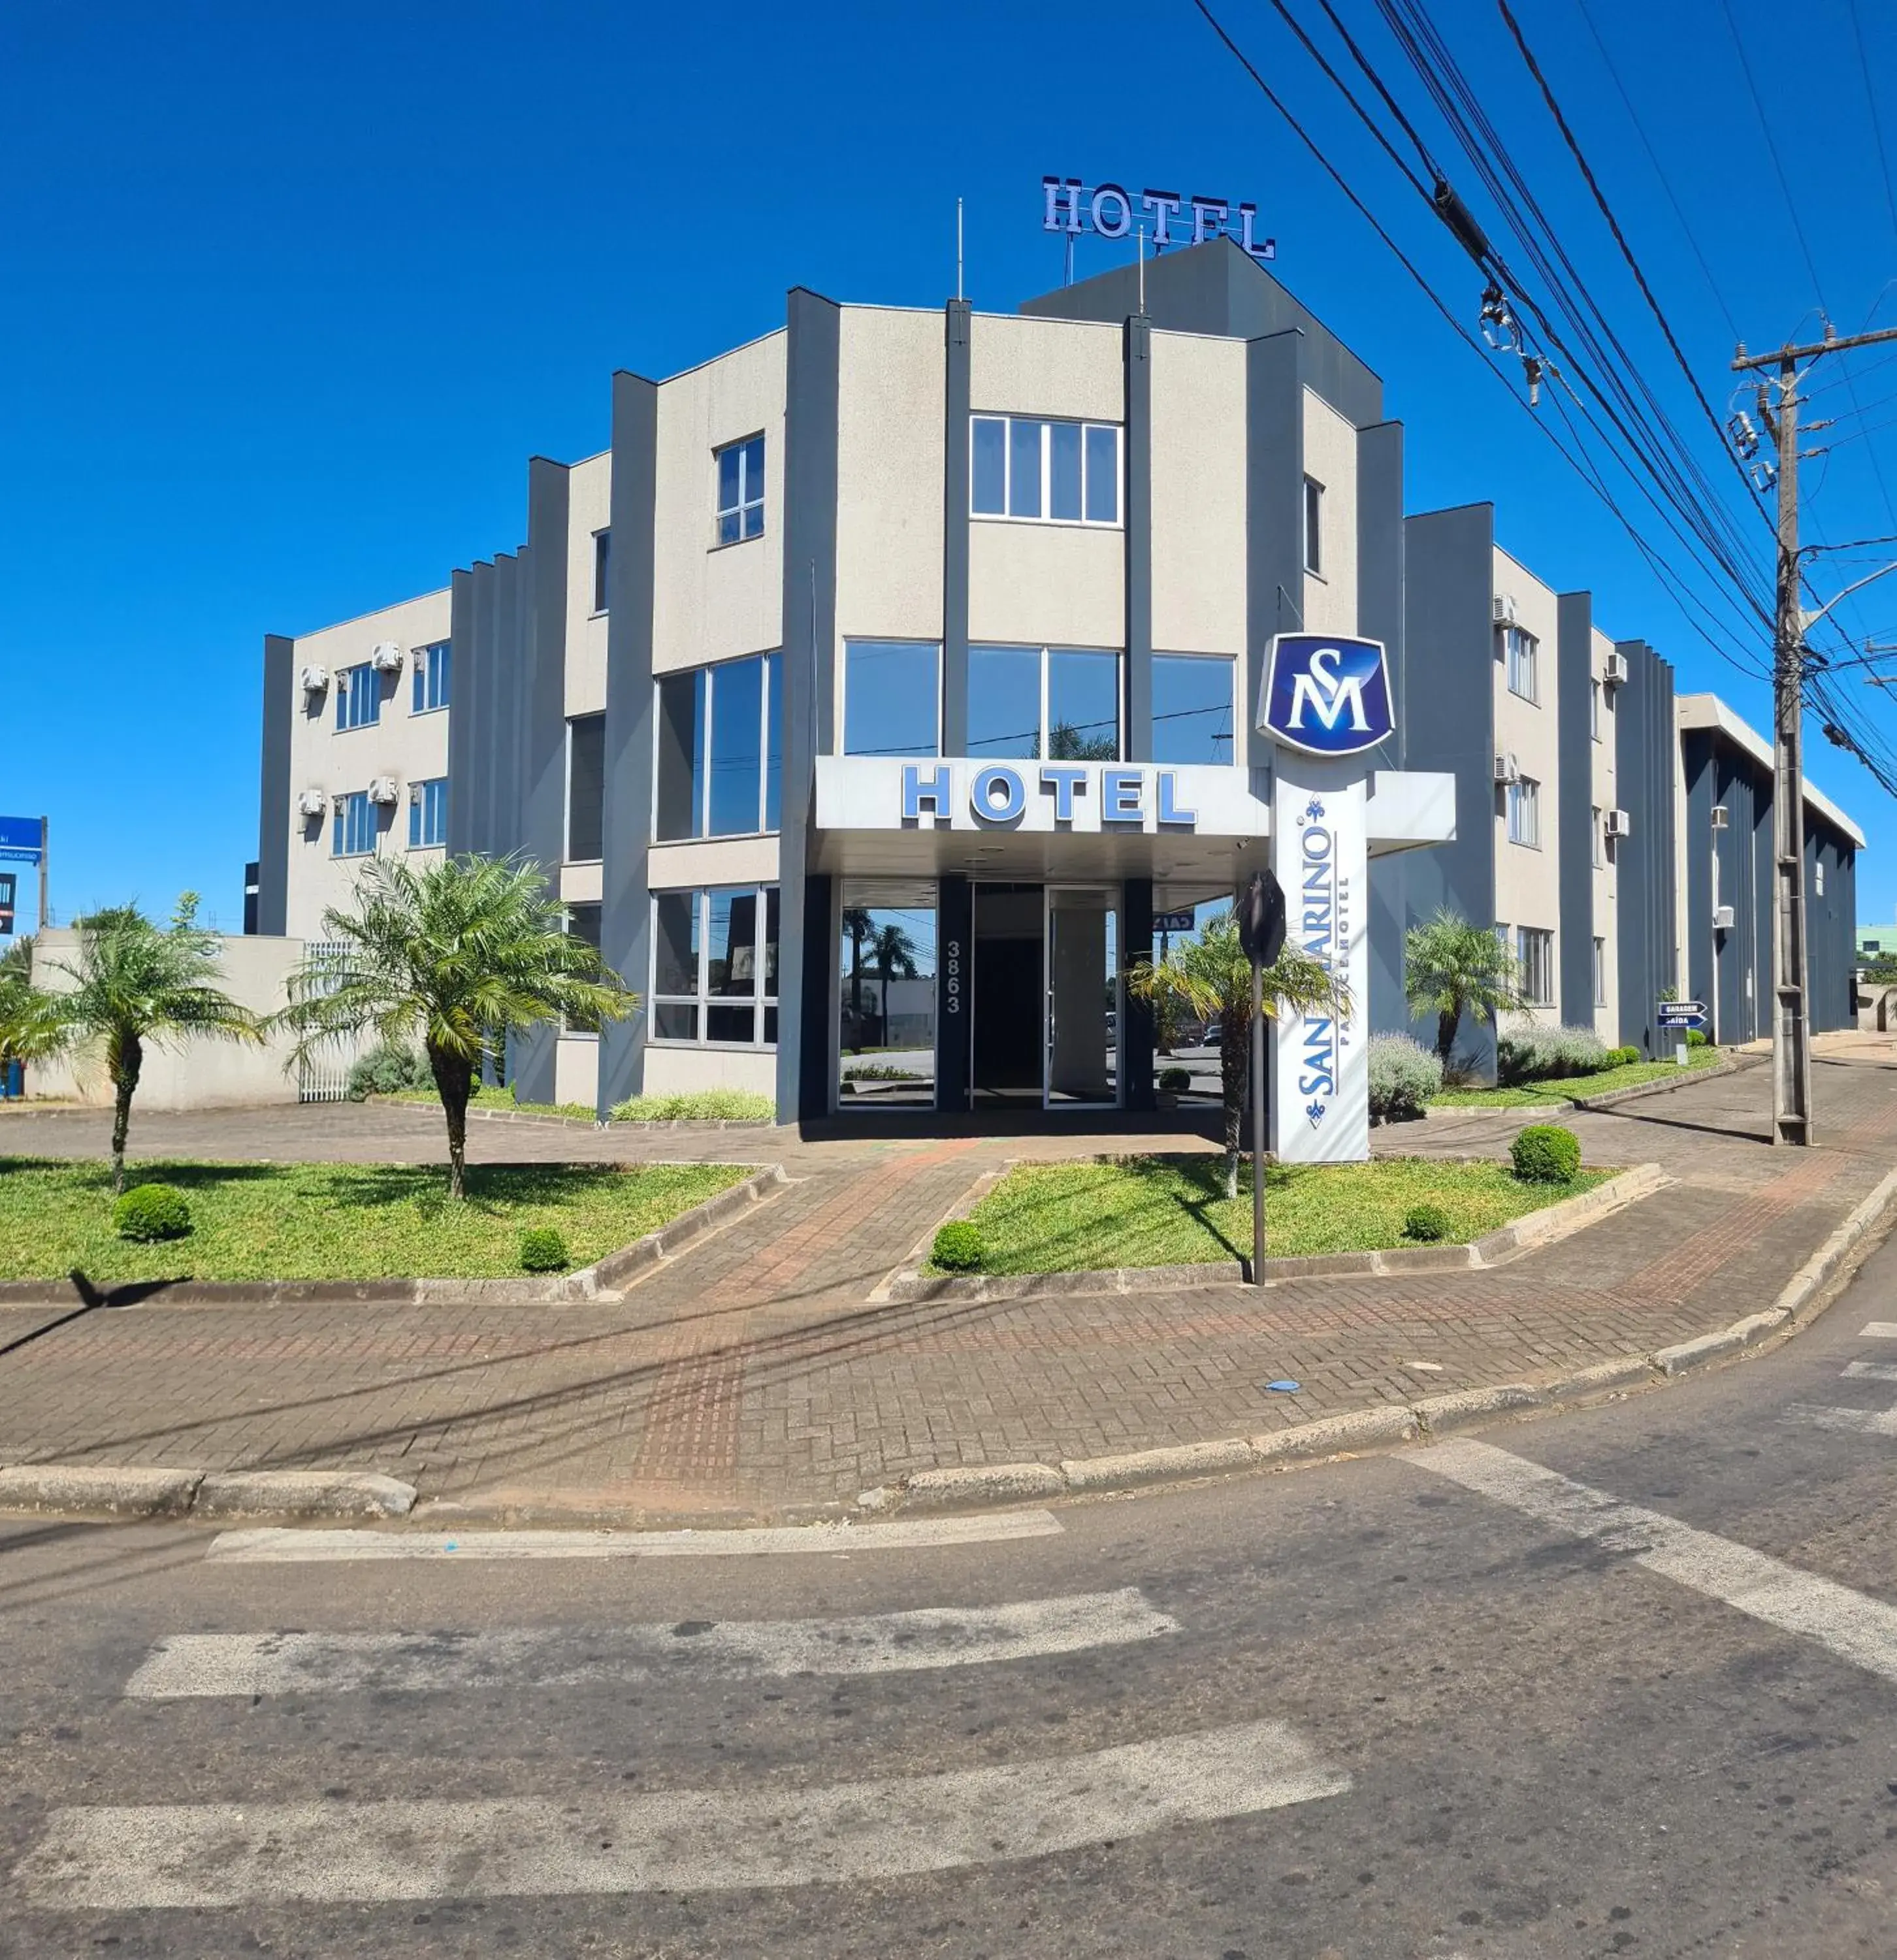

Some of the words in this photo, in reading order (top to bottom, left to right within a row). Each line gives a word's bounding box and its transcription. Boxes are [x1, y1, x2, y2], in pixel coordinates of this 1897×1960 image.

[1043, 176, 1275, 260] HOTEL
[901, 764, 1197, 824] HOTEL
[1303, 826, 1331, 972] ARINO
[947, 940, 960, 1013] 3863
[1340, 959, 1350, 1045] PACE
[1299, 1015, 1333, 1096] SAN
